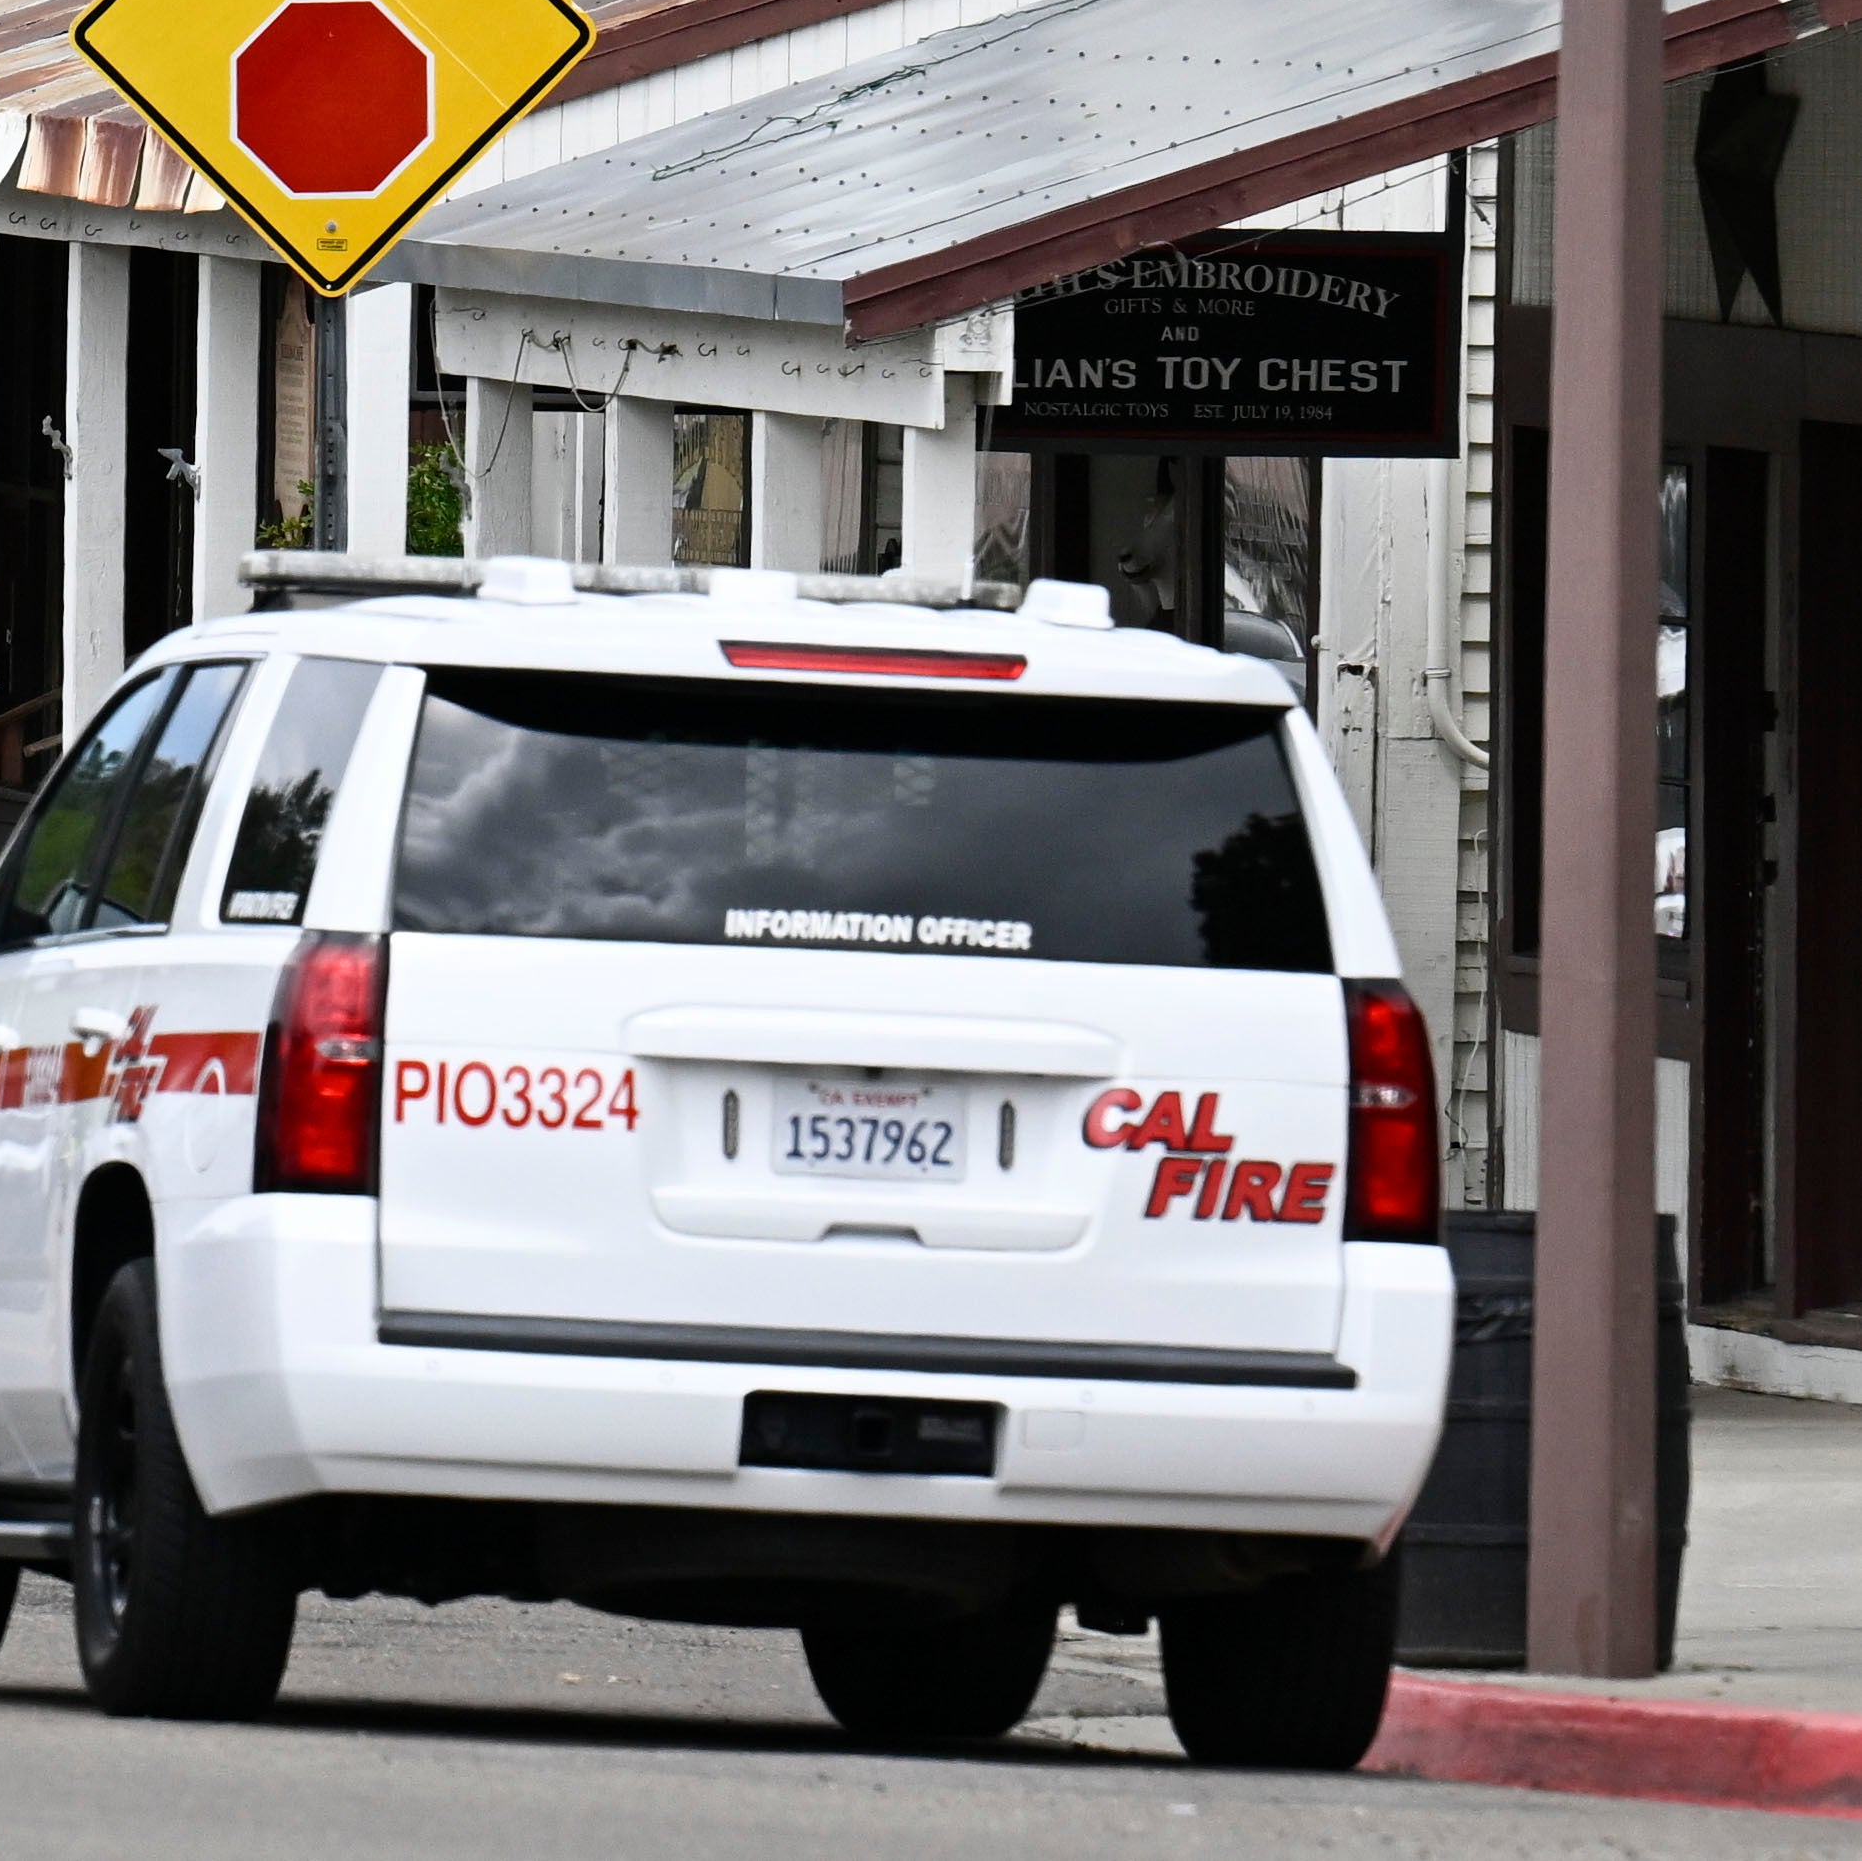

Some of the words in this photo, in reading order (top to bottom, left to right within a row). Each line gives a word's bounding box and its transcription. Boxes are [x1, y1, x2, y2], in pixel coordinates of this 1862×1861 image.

[1105, 297, 1163, 315] GIFTS
[1172, 297, 1189, 315] &
[1197, 297, 1256, 316] MORE
[1131, 259, 1402, 320] EMBROIDERY
[1160, 325, 1200, 342] AND
[1156, 356, 1242, 390] TOY
[1257, 357, 1409, 393] CHEST
[1023, 402, 1122, 418] NOSTALGIC
[1125, 402, 1169, 419] TOYS
[1231, 404, 1270, 421] JULY
[1299, 405, 1333, 422] 1984
[723, 908, 914, 943] INFORMATION
[916, 914, 1034, 951] OFFICER
[393, 1059, 640, 1132] PIO3324
[851, 1090, 921, 1108] EXEMPT
[786, 1114, 955, 1167] 1537962
[1081, 1087, 1236, 1154] CAL
[1143, 1156, 1337, 1226] FIRE
